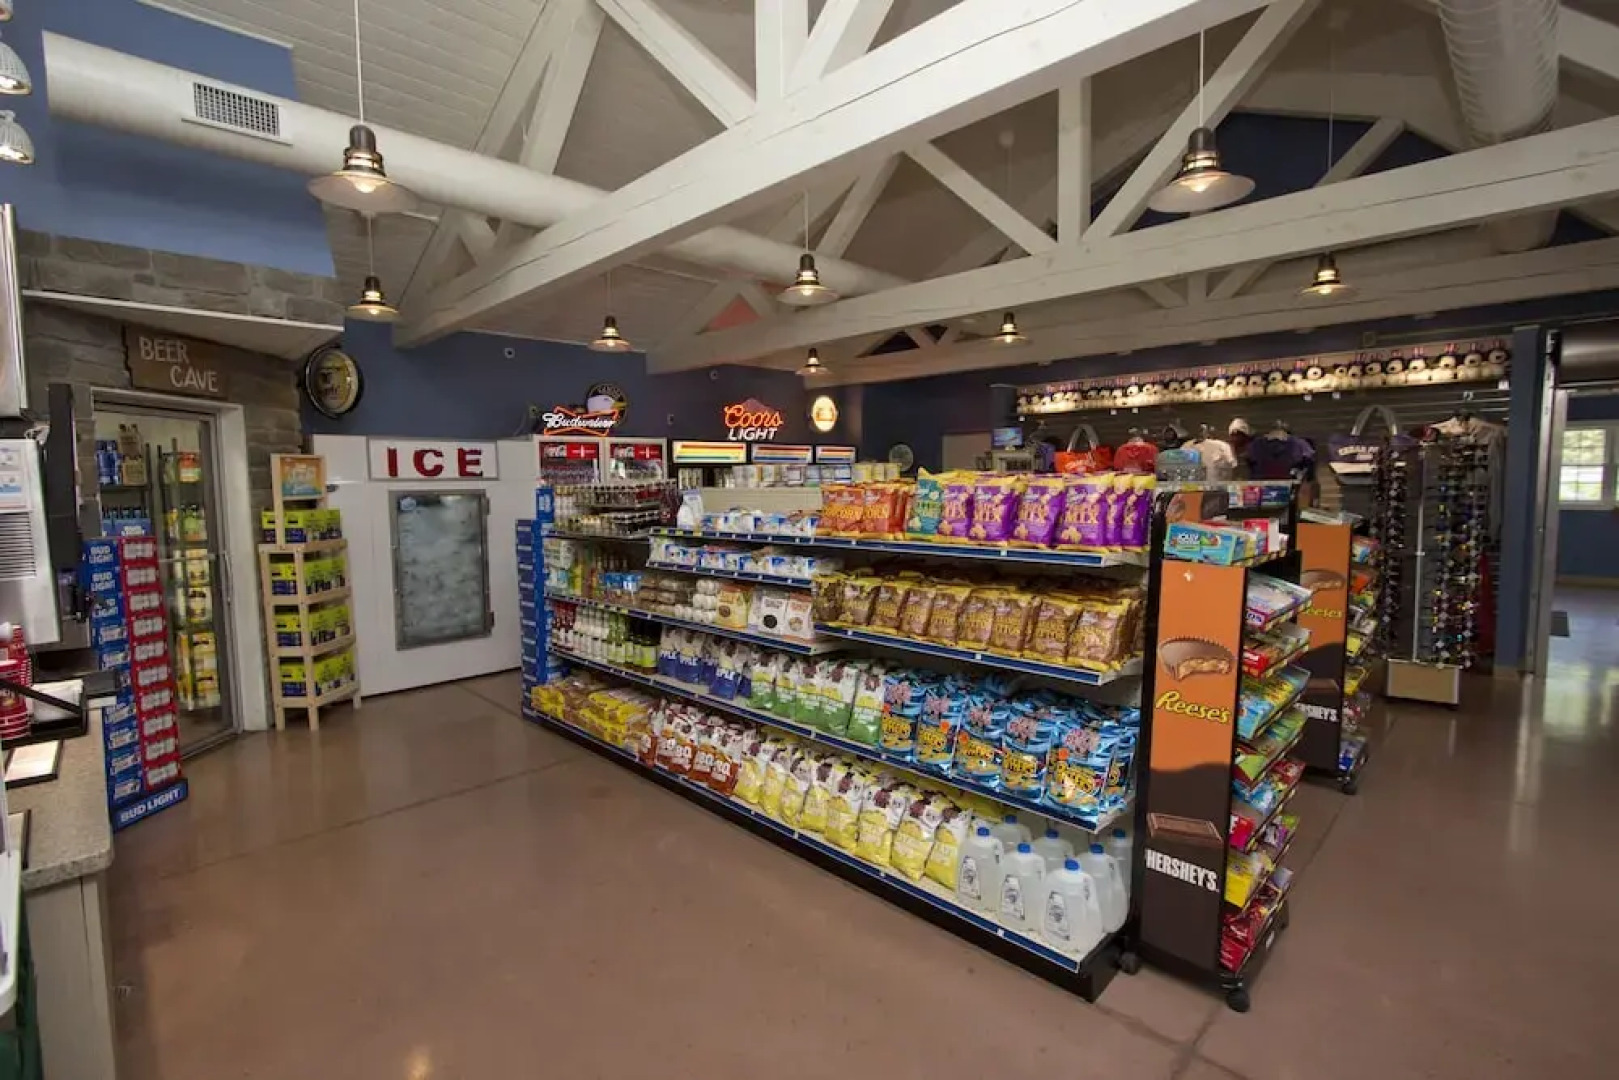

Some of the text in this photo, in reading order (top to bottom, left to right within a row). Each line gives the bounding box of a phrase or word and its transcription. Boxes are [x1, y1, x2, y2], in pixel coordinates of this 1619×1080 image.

[139, 336, 189, 364] BEER
[169, 365, 219, 393] CAVE
[542, 412, 616, 428] Budweiser
[724, 404, 783, 428] Coors
[727, 427, 778, 441] LIGHT
[387, 446, 483, 478] ICE
[91, 580, 116, 591] LIGHT
[92, 572, 112, 582] BUD
[1155, 690, 1230, 724] Reese's
[121, 788, 181, 822] BUD LIGHT
[1144, 849, 1219, 892] HERSHEY'S
